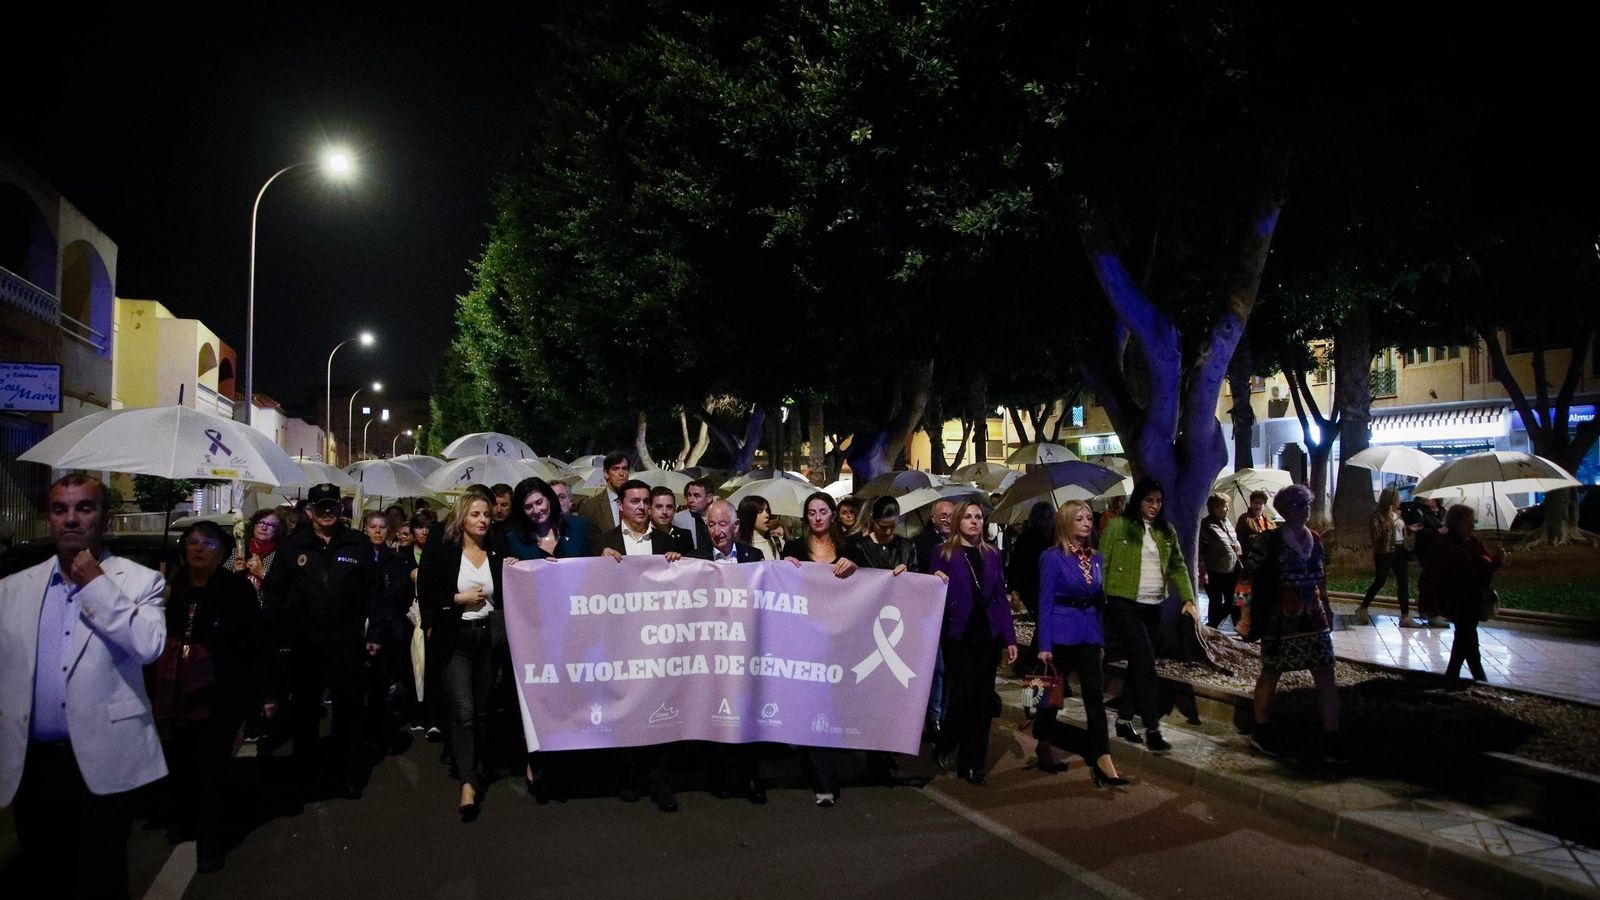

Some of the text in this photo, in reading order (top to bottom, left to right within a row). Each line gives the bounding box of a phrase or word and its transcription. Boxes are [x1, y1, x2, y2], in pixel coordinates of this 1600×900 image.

[9, 388, 56, 404] Mary
[569, 588, 809, 616] ROQUETAS DE MAR
[640, 621, 747, 645] CONTRA
[524, 652, 844, 684] LA VIOLENCIA DE GÉNERO
